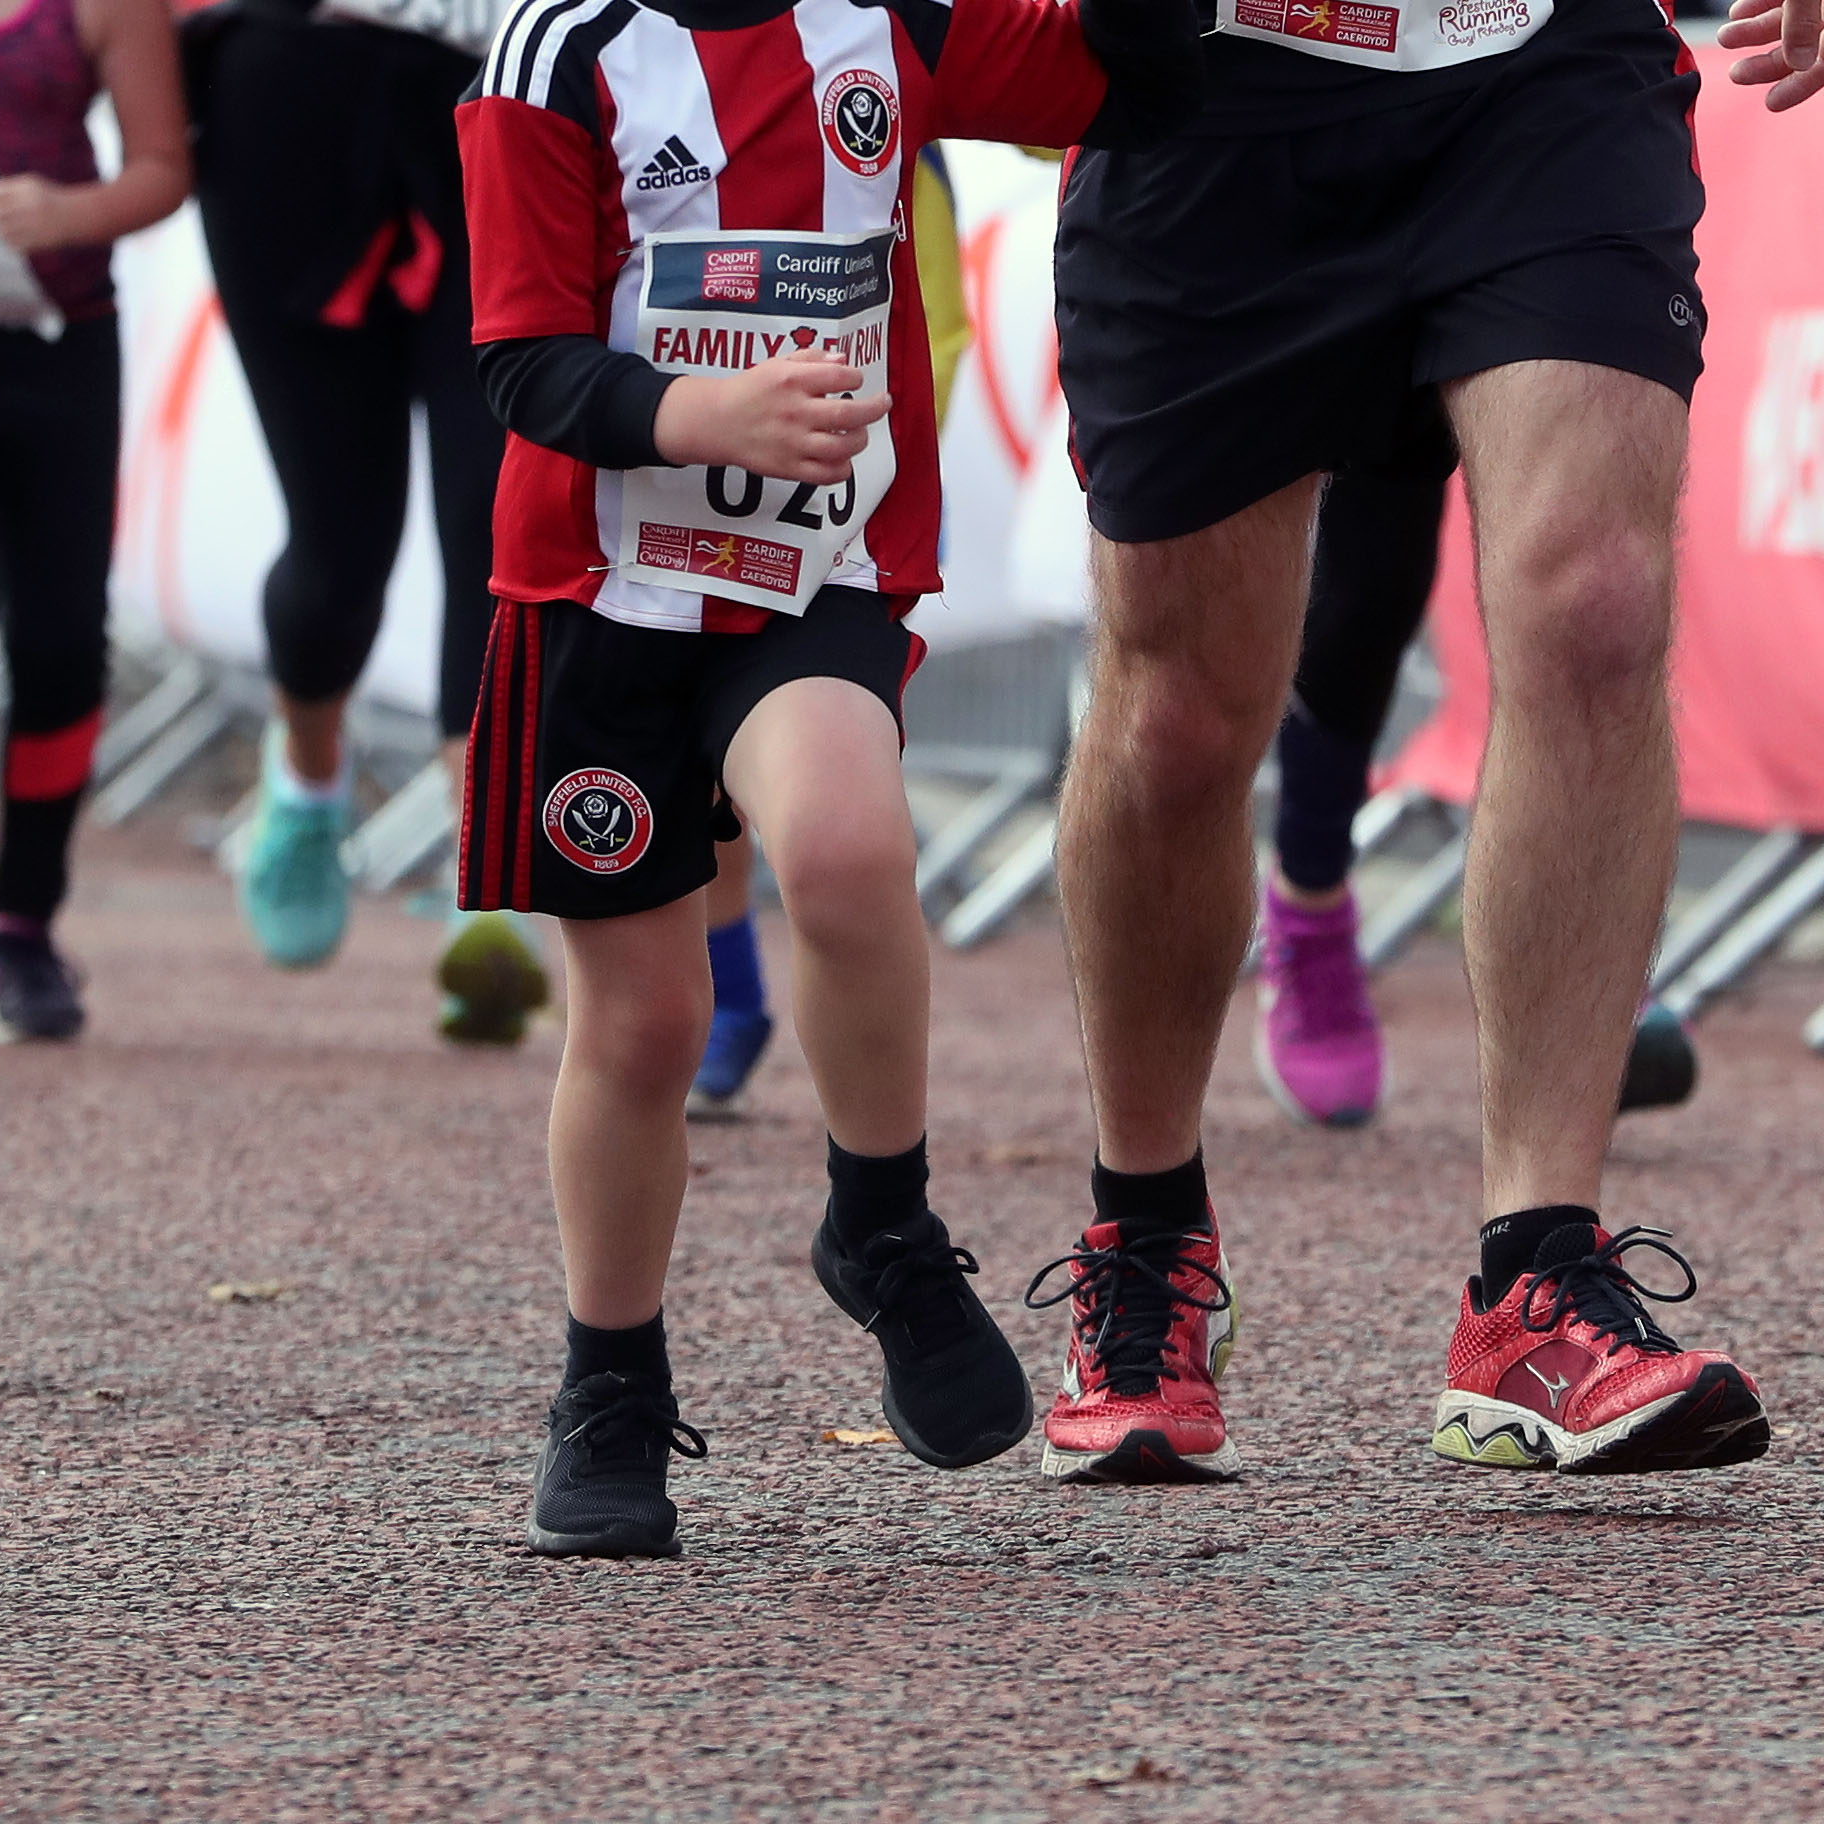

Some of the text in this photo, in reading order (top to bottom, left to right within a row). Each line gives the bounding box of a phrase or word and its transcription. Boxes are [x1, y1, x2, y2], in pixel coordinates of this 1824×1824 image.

[1339, 5, 1393, 21] CARDIFF
[1439, 2, 1530, 35] Running
[1336, 31, 1389, 47] CAERDYDD
[823, 72, 856, 126] SHEFFIELD
[857, 71, 891, 98] UNITED
[636, 164, 712, 191] adidas
[707, 251, 758, 266] CARDIFF
[776, 253, 841, 274] Cardiff
[775, 281, 848, 306] Prifysgol
[652, 326, 787, 369] FAMILY
[855, 321, 882, 368] RUN
[744, 542, 795, 562] CARDIFF
[740, 570, 791, 590] CAERDYDD
[547, 775, 589, 827] SHEFFIELD
[592, 774, 636, 798] UNITED
